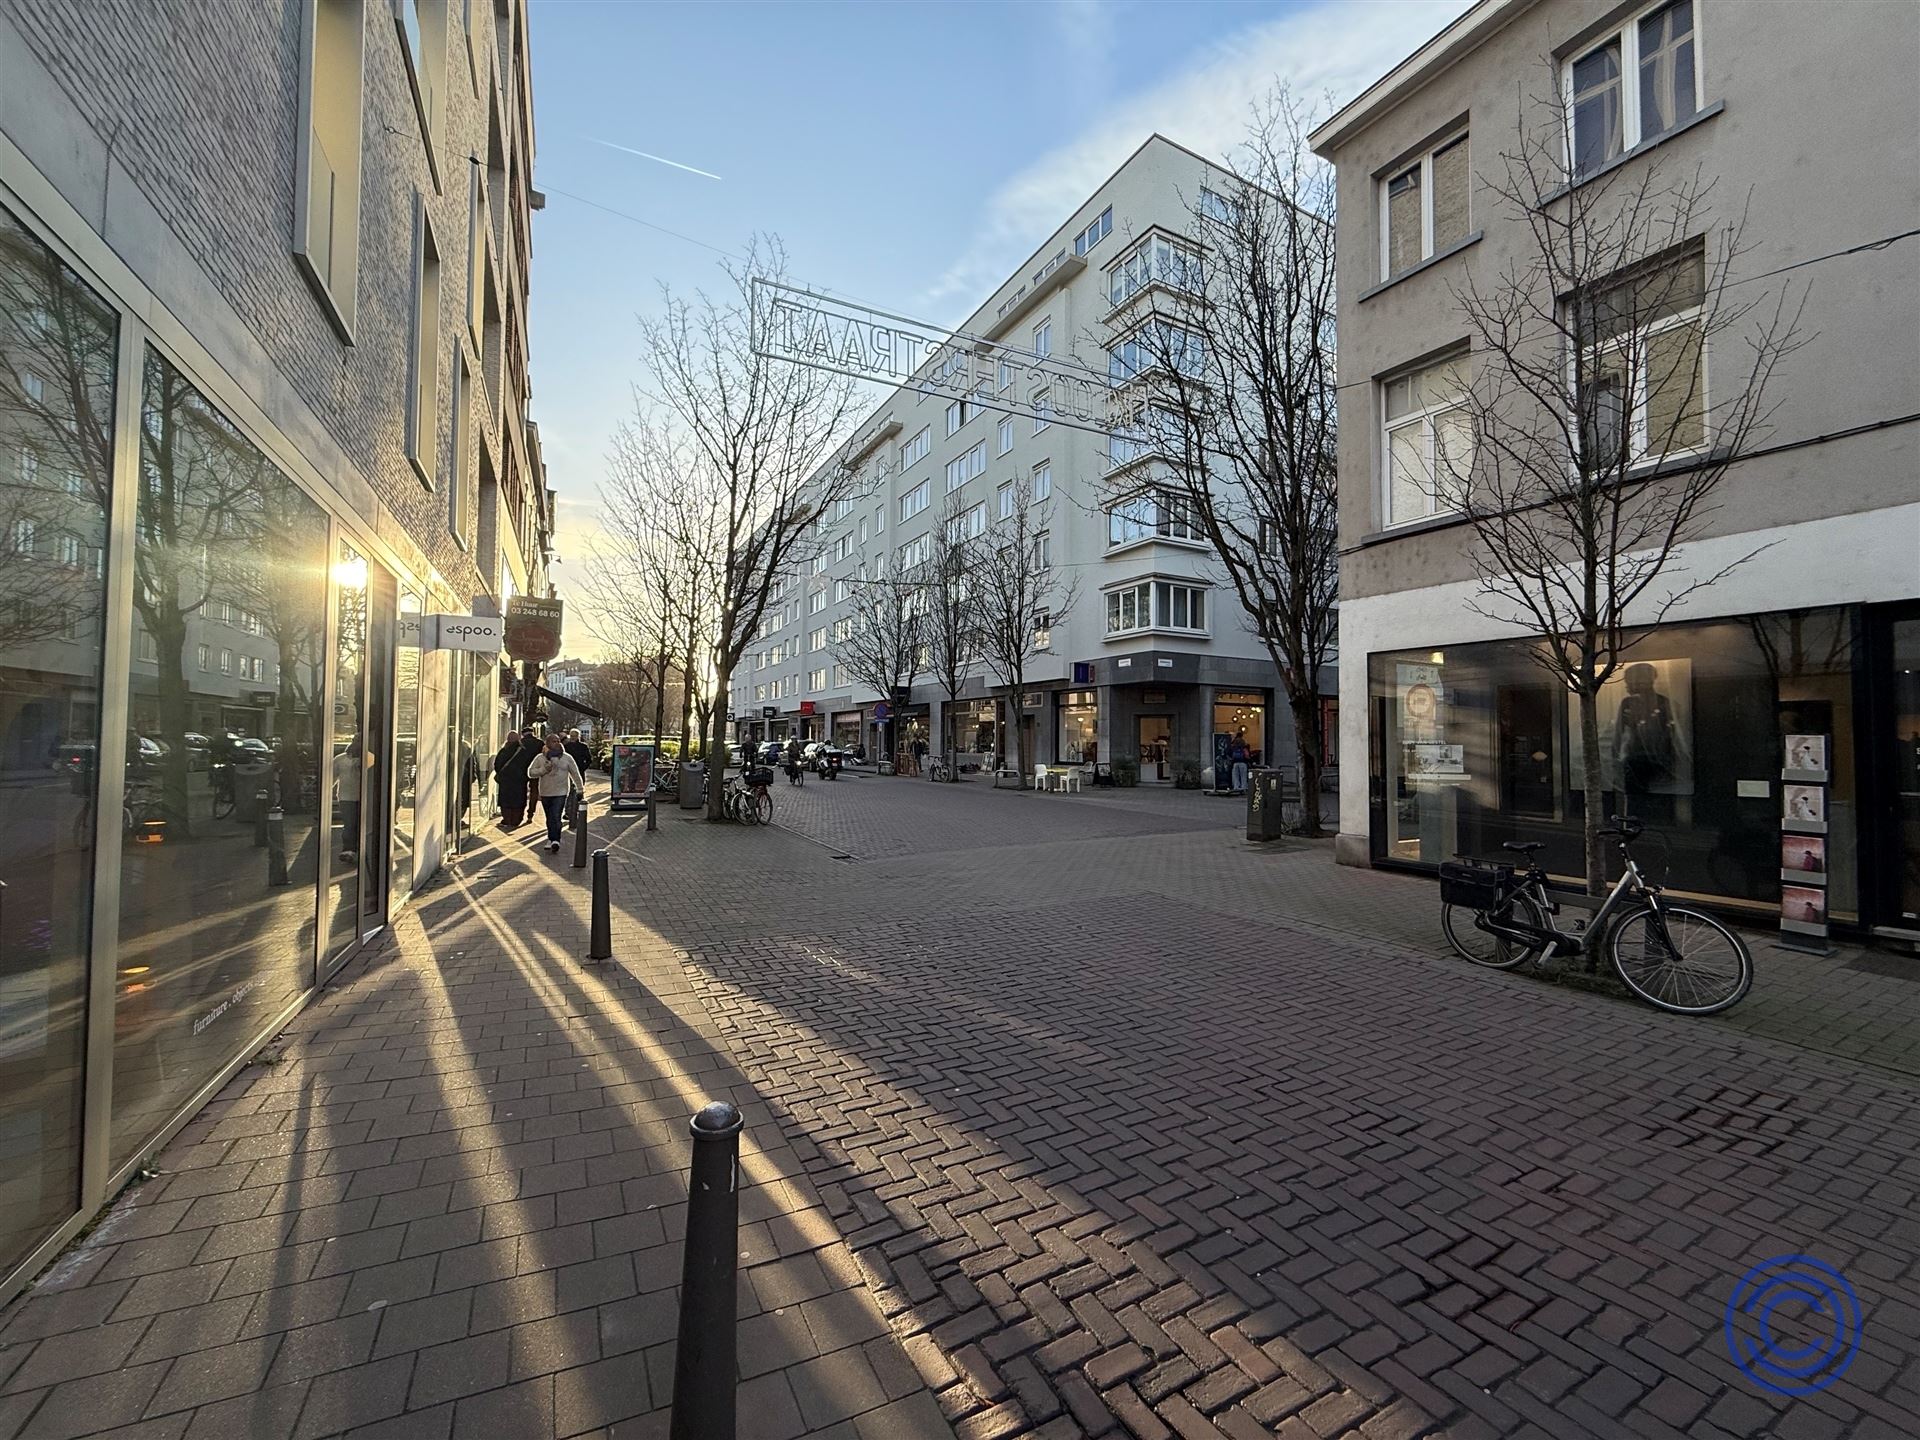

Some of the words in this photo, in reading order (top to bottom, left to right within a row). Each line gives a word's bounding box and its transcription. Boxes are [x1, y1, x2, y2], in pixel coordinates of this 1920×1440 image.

[511, 607, 521, 615] 03
[522, 608, 537, 616] 248
[538, 609, 548, 617] 68
[549, 610, 560, 618] 60
[446, 625, 497, 642] espoo.
